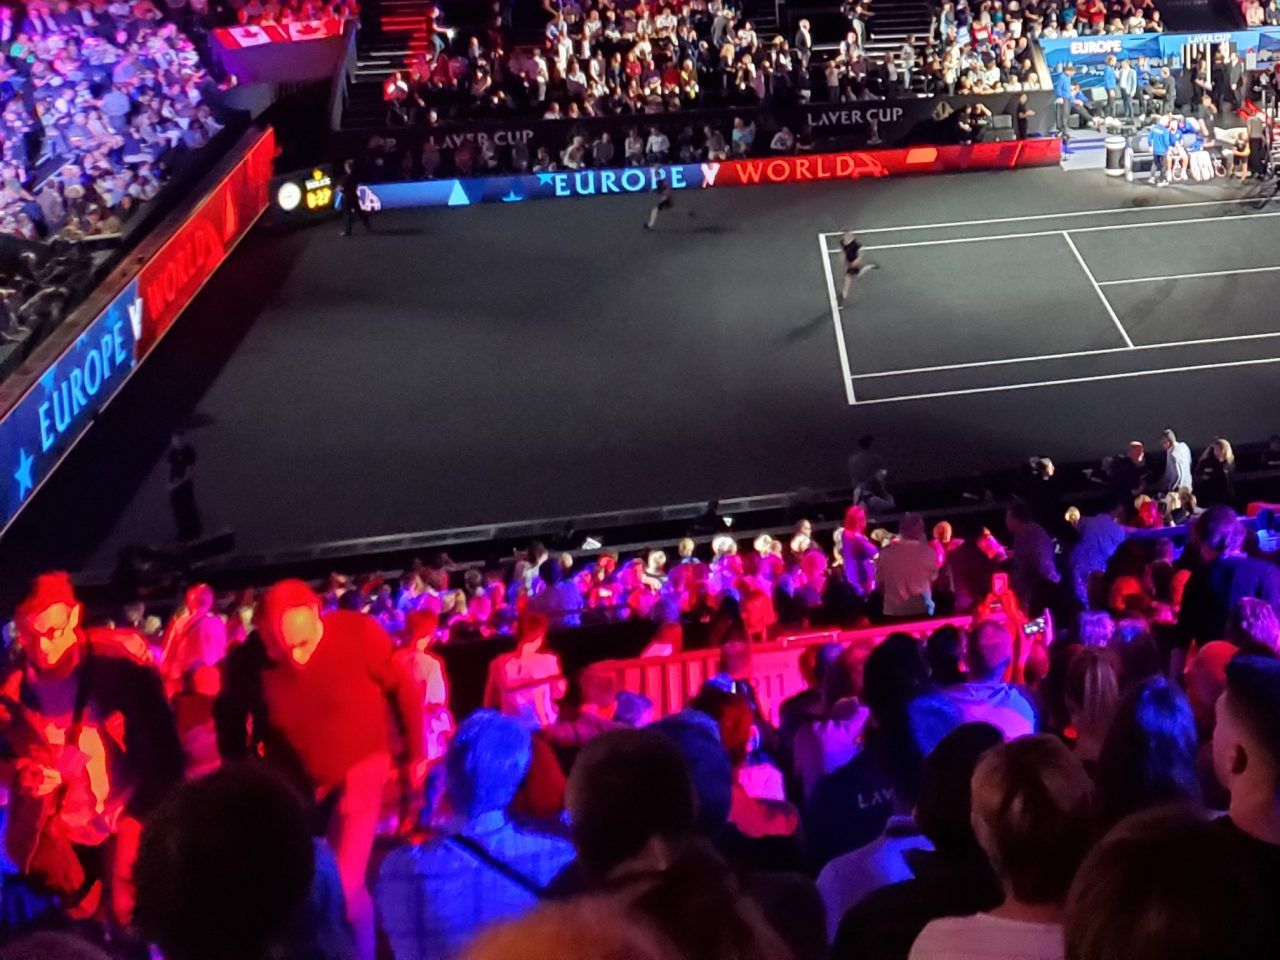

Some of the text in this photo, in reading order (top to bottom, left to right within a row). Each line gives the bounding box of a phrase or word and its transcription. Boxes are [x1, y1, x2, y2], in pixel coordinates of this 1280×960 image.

[1071, 39, 1122, 55] EUROPE
[808, 107, 904, 127] LAVER CUP
[494, 129, 534, 146] CUP
[555, 166, 687, 196] EUROPE
[736, 155, 855, 185] WORLD
[38, 321, 127, 452] EUROPE
[147, 228, 216, 321] WORLD
